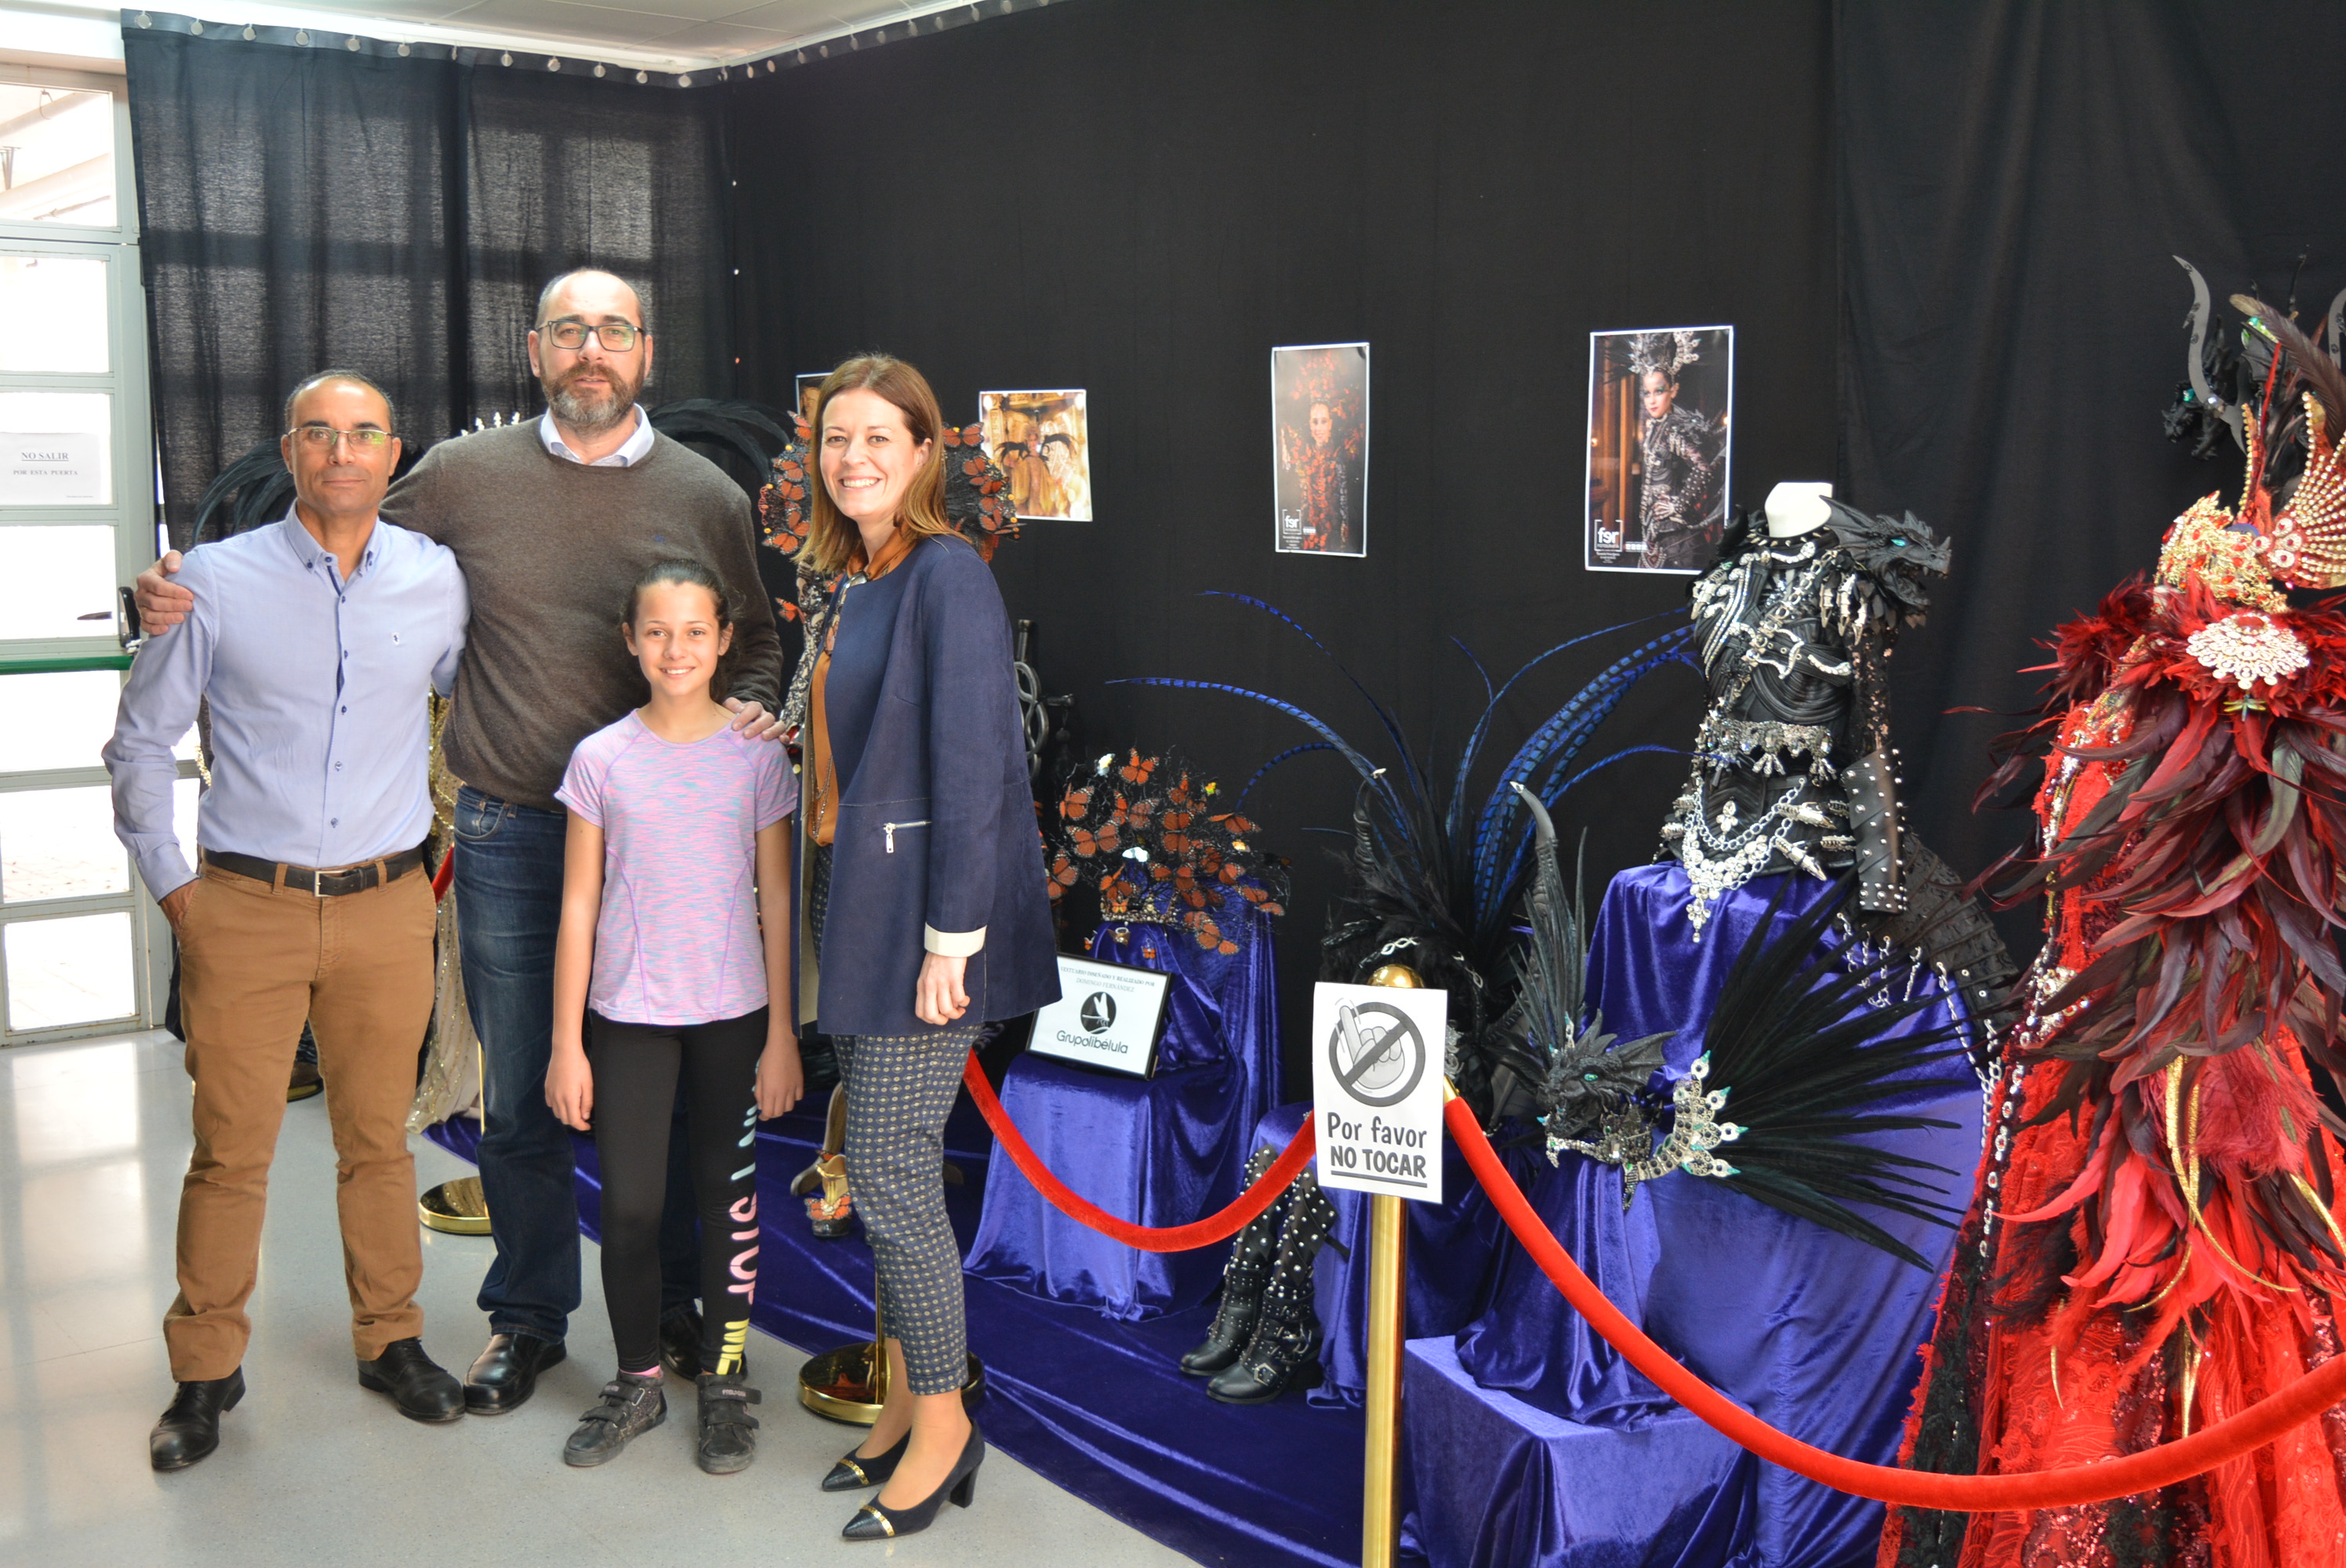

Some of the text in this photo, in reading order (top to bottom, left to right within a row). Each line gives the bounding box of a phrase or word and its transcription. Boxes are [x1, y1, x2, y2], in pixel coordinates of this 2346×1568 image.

[21, 452, 69, 460] NO SALIR
[1076, 977, 1135, 993] DOMINGO FERNÁNDEZ
[1087, 971, 1112, 980] DISEÑADO
[1117, 975, 1144, 985] REALIZADO
[1056, 1029, 1129, 1054] Grupolibélula
[1327, 1112, 1427, 1149] Por favor
[1331, 1145, 1426, 1178] NO TOCAR
